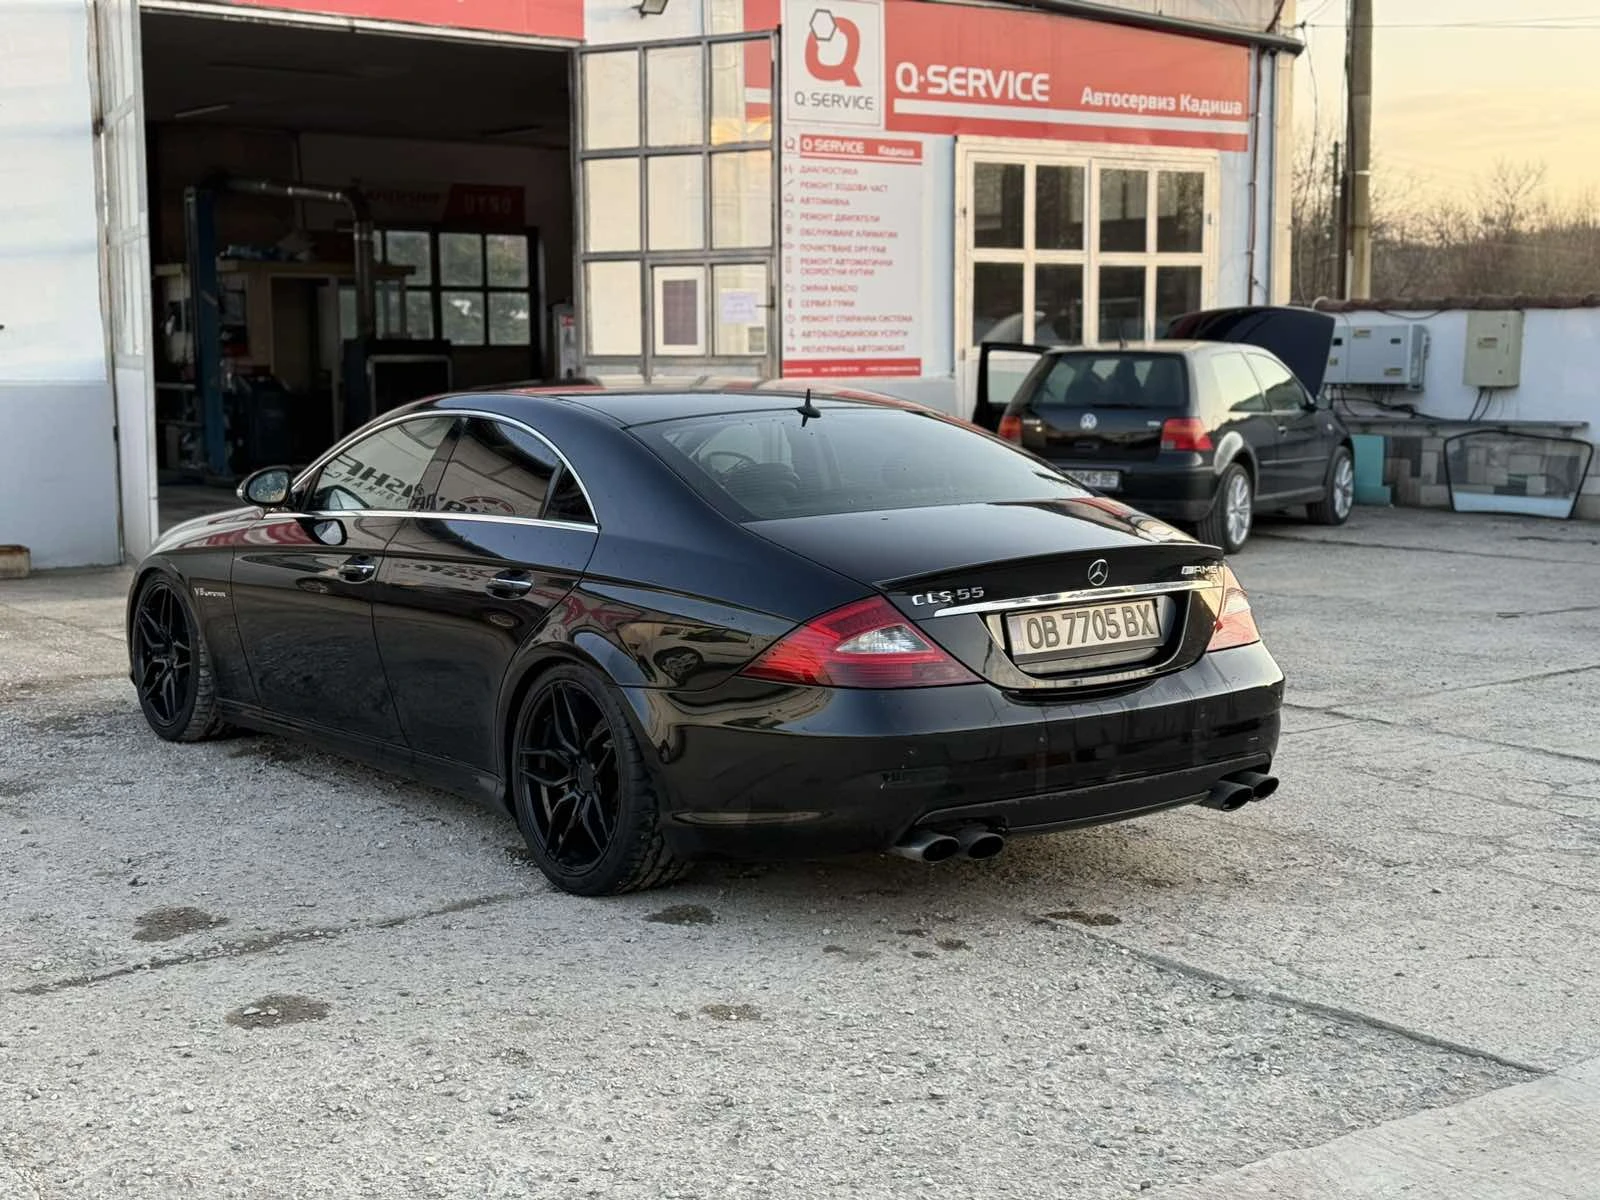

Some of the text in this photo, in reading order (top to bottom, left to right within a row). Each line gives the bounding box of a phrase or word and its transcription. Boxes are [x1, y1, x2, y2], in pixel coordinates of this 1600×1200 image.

[1080, 85, 1243, 116] Автосервиз Кадиша
[799, 165, 858, 175] ДИАГНОСТИКА
[799, 181, 833, 190] РЕМОНТ
[870, 184, 889, 193] ЧАСТ
[799, 212, 880, 223] РЕМОНТ ДВИГАТЕЛИ
[799, 243, 852, 252] ПОЧИСТВАНЕ
[799, 257, 832, 265] РЕМОНТ
[800, 284, 859, 293] СМЯНА МАСЛО
[800, 315, 834, 323] РЕМОНТ
[879, 314, 914, 322] СИСТЕМА
[911, 586, 985, 607] CLS 55
